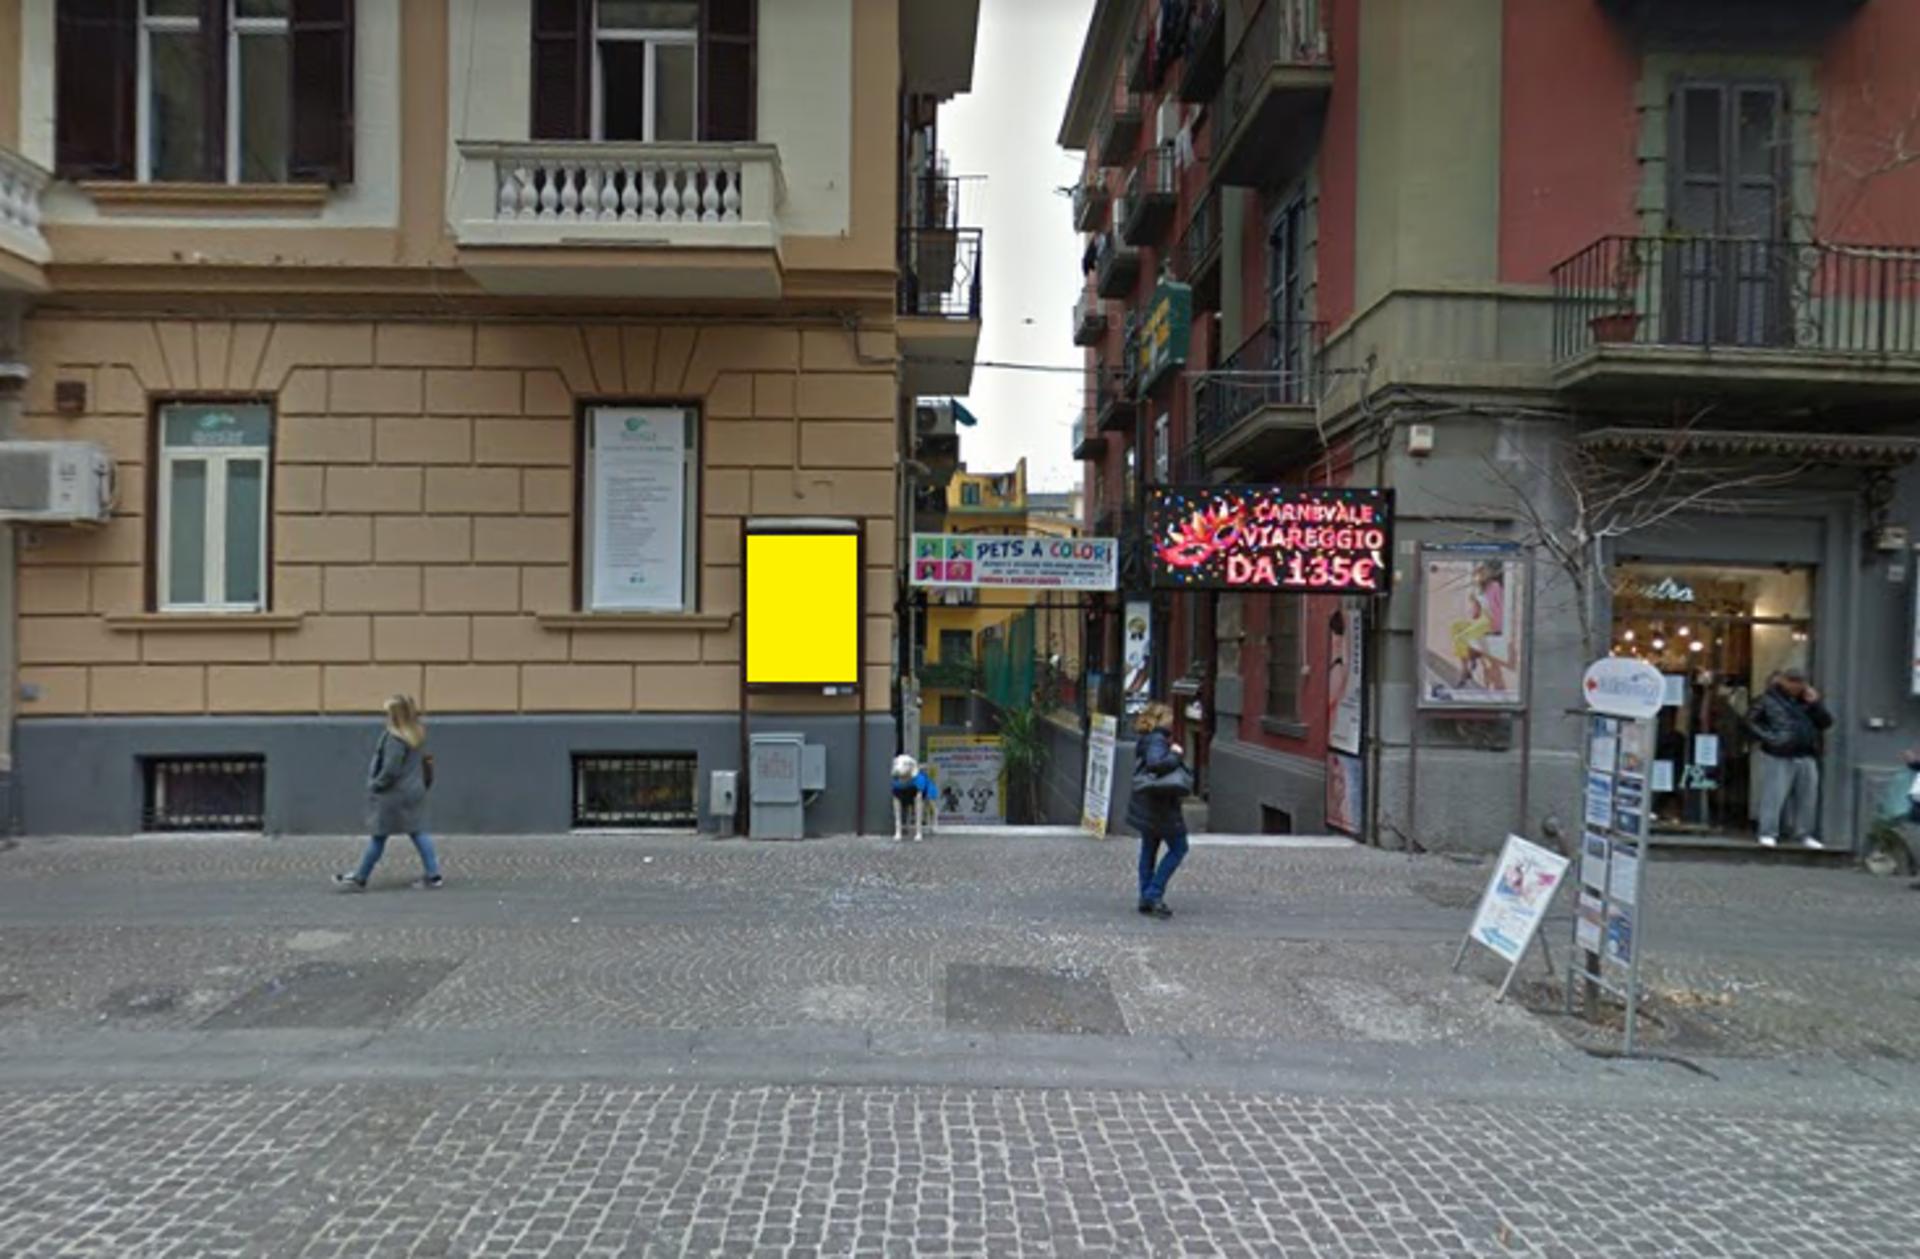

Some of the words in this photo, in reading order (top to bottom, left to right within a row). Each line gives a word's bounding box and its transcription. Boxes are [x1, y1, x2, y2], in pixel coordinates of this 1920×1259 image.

[1255, 502, 1373, 523] CARNEVALE
[1244, 526, 1384, 549] VIAREGGIO
[977, 540, 1024, 560] PETS
[1031, 541, 1043, 557] A
[1227, 555, 1277, 583] DA
[1283, 553, 1376, 584] 135€
